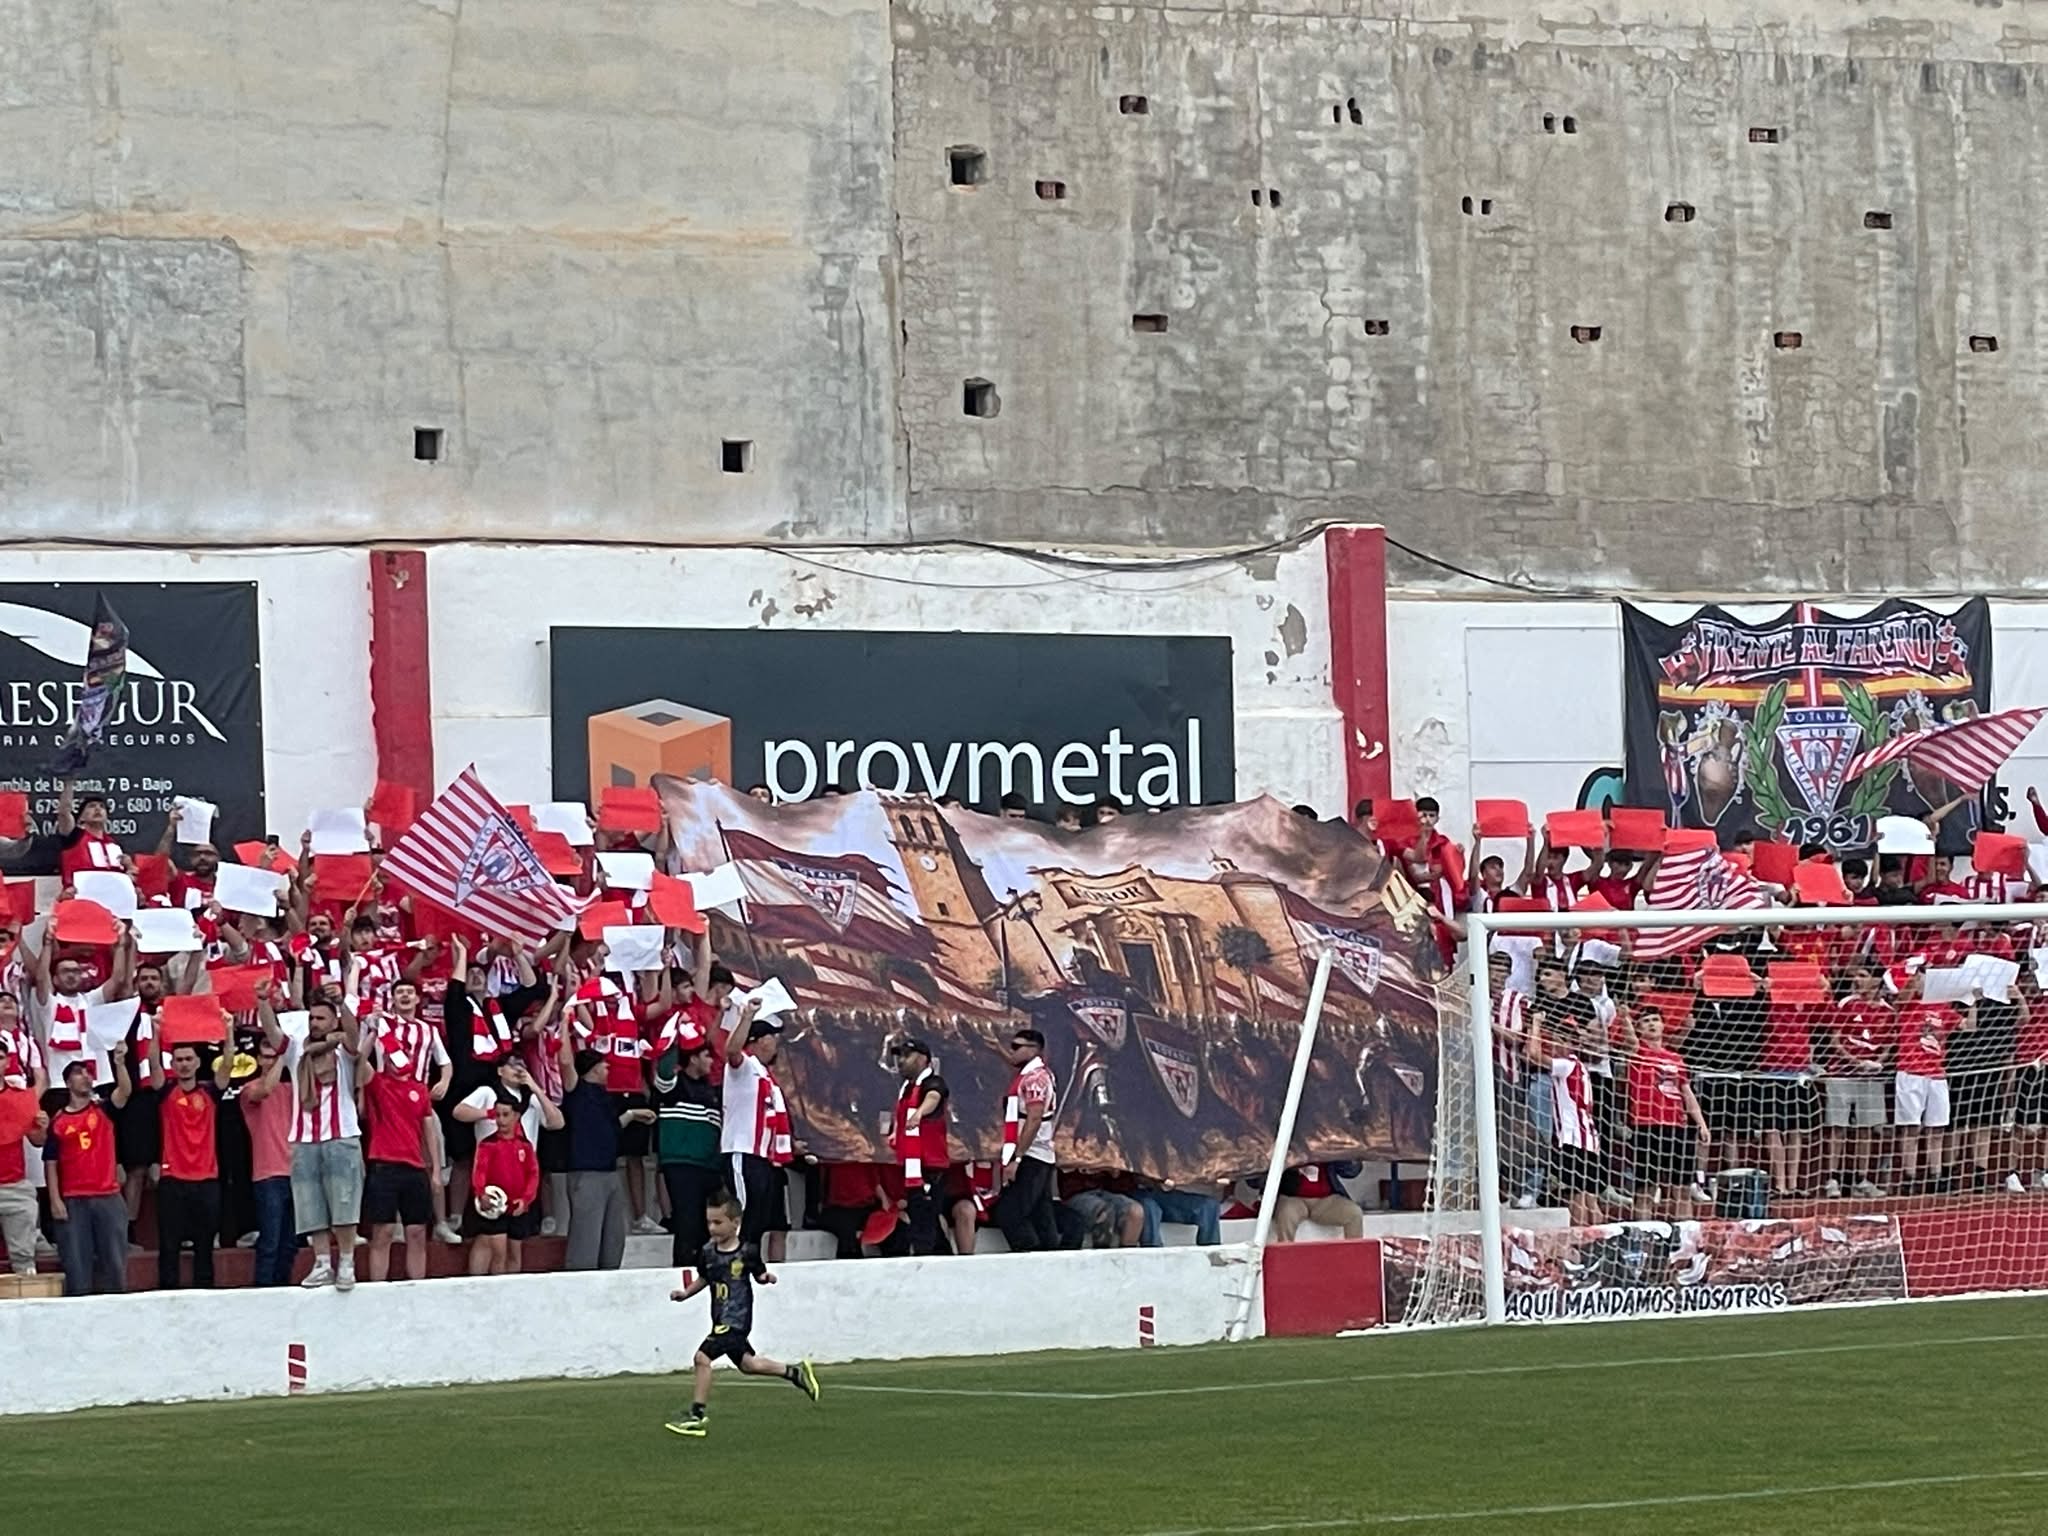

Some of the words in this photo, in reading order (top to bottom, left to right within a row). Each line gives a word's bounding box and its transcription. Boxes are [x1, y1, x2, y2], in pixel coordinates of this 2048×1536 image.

[1696, 623, 1796, 681] FRENTE
[1800, 617, 1935, 671] ALFARERO
[106, 733, 196, 746] EGUROS
[764, 718, 1201, 807] provmetal
[34, 776, 50, 792] de
[53, 777, 65, 792] la
[72, 779, 106, 793] anta,
[107, 777, 117, 791] 7
[120, 777, 130, 791] B
[142, 777, 173, 794] Bajo
[1783, 815, 1871, 846] 1961
[79, 1131, 92, 1150] 6
[715, 1282, 729, 1301] 10
[1564, 1288, 1675, 1316] MANDAMOS
[1683, 1284, 1785, 1312] NOSOTROS
